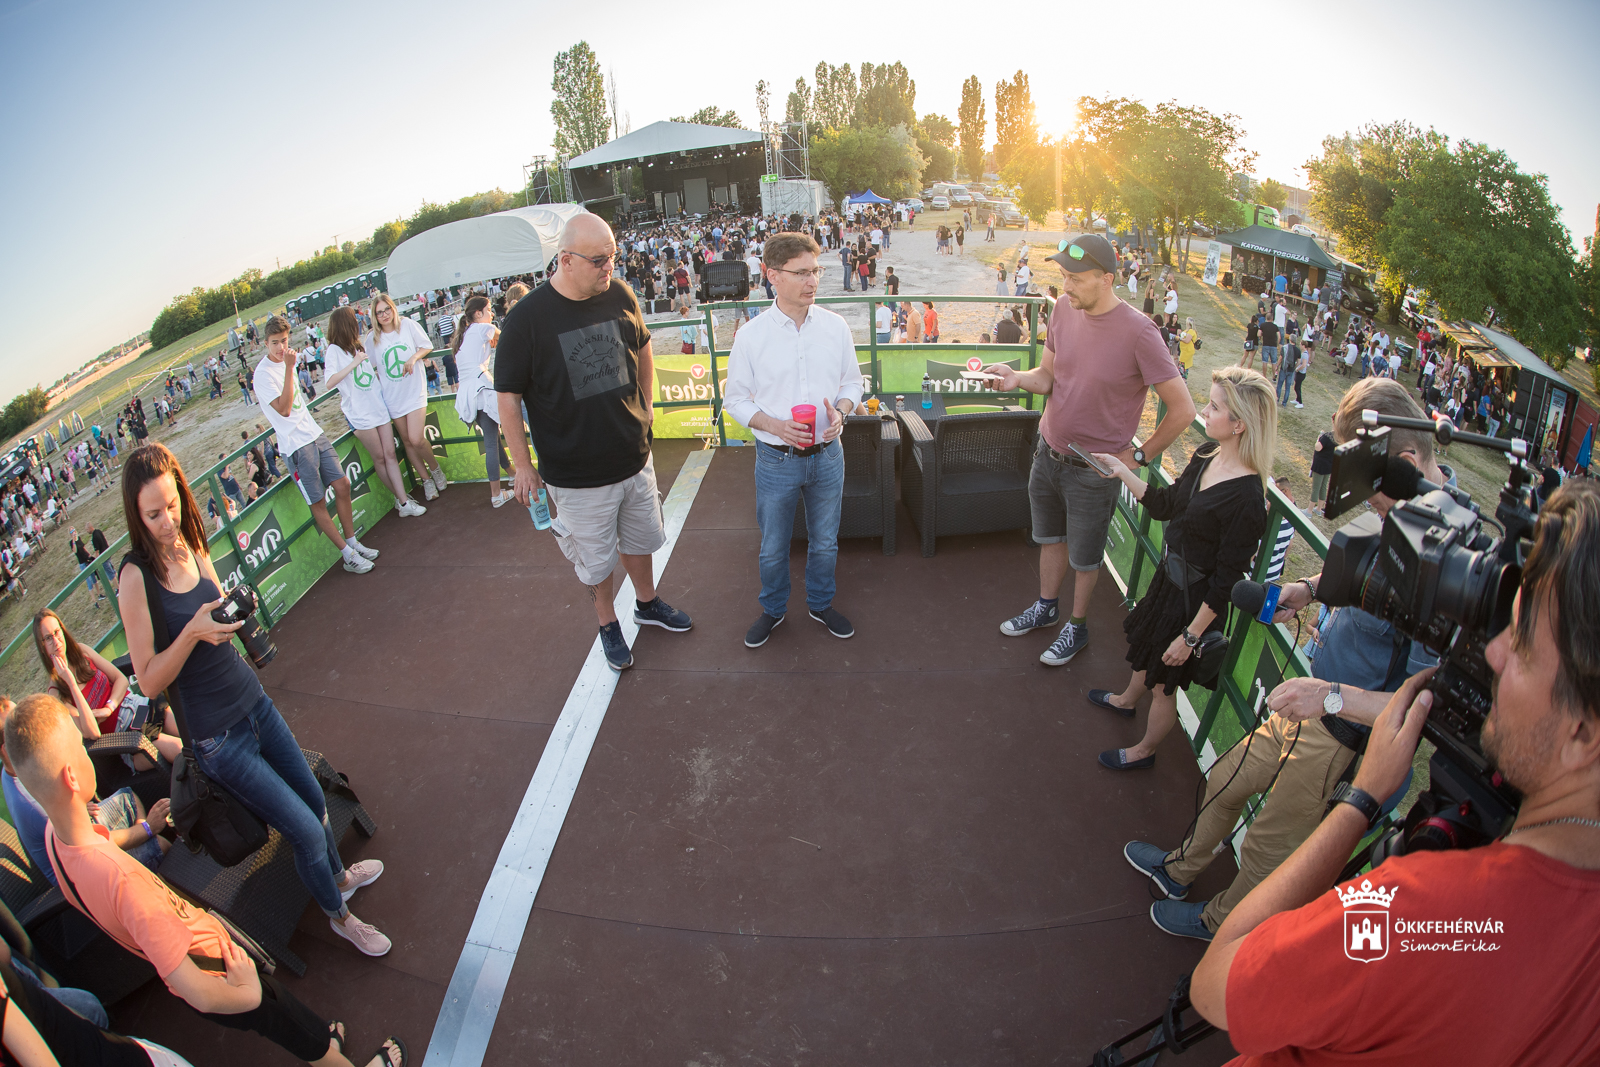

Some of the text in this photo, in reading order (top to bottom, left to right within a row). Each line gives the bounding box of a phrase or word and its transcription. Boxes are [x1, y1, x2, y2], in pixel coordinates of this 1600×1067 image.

[1240, 241, 1271, 253] KATONAI
[568, 342, 586, 362] PAUL
[591, 333, 621, 349] SHARK
[577, 363, 621, 390] yachting
